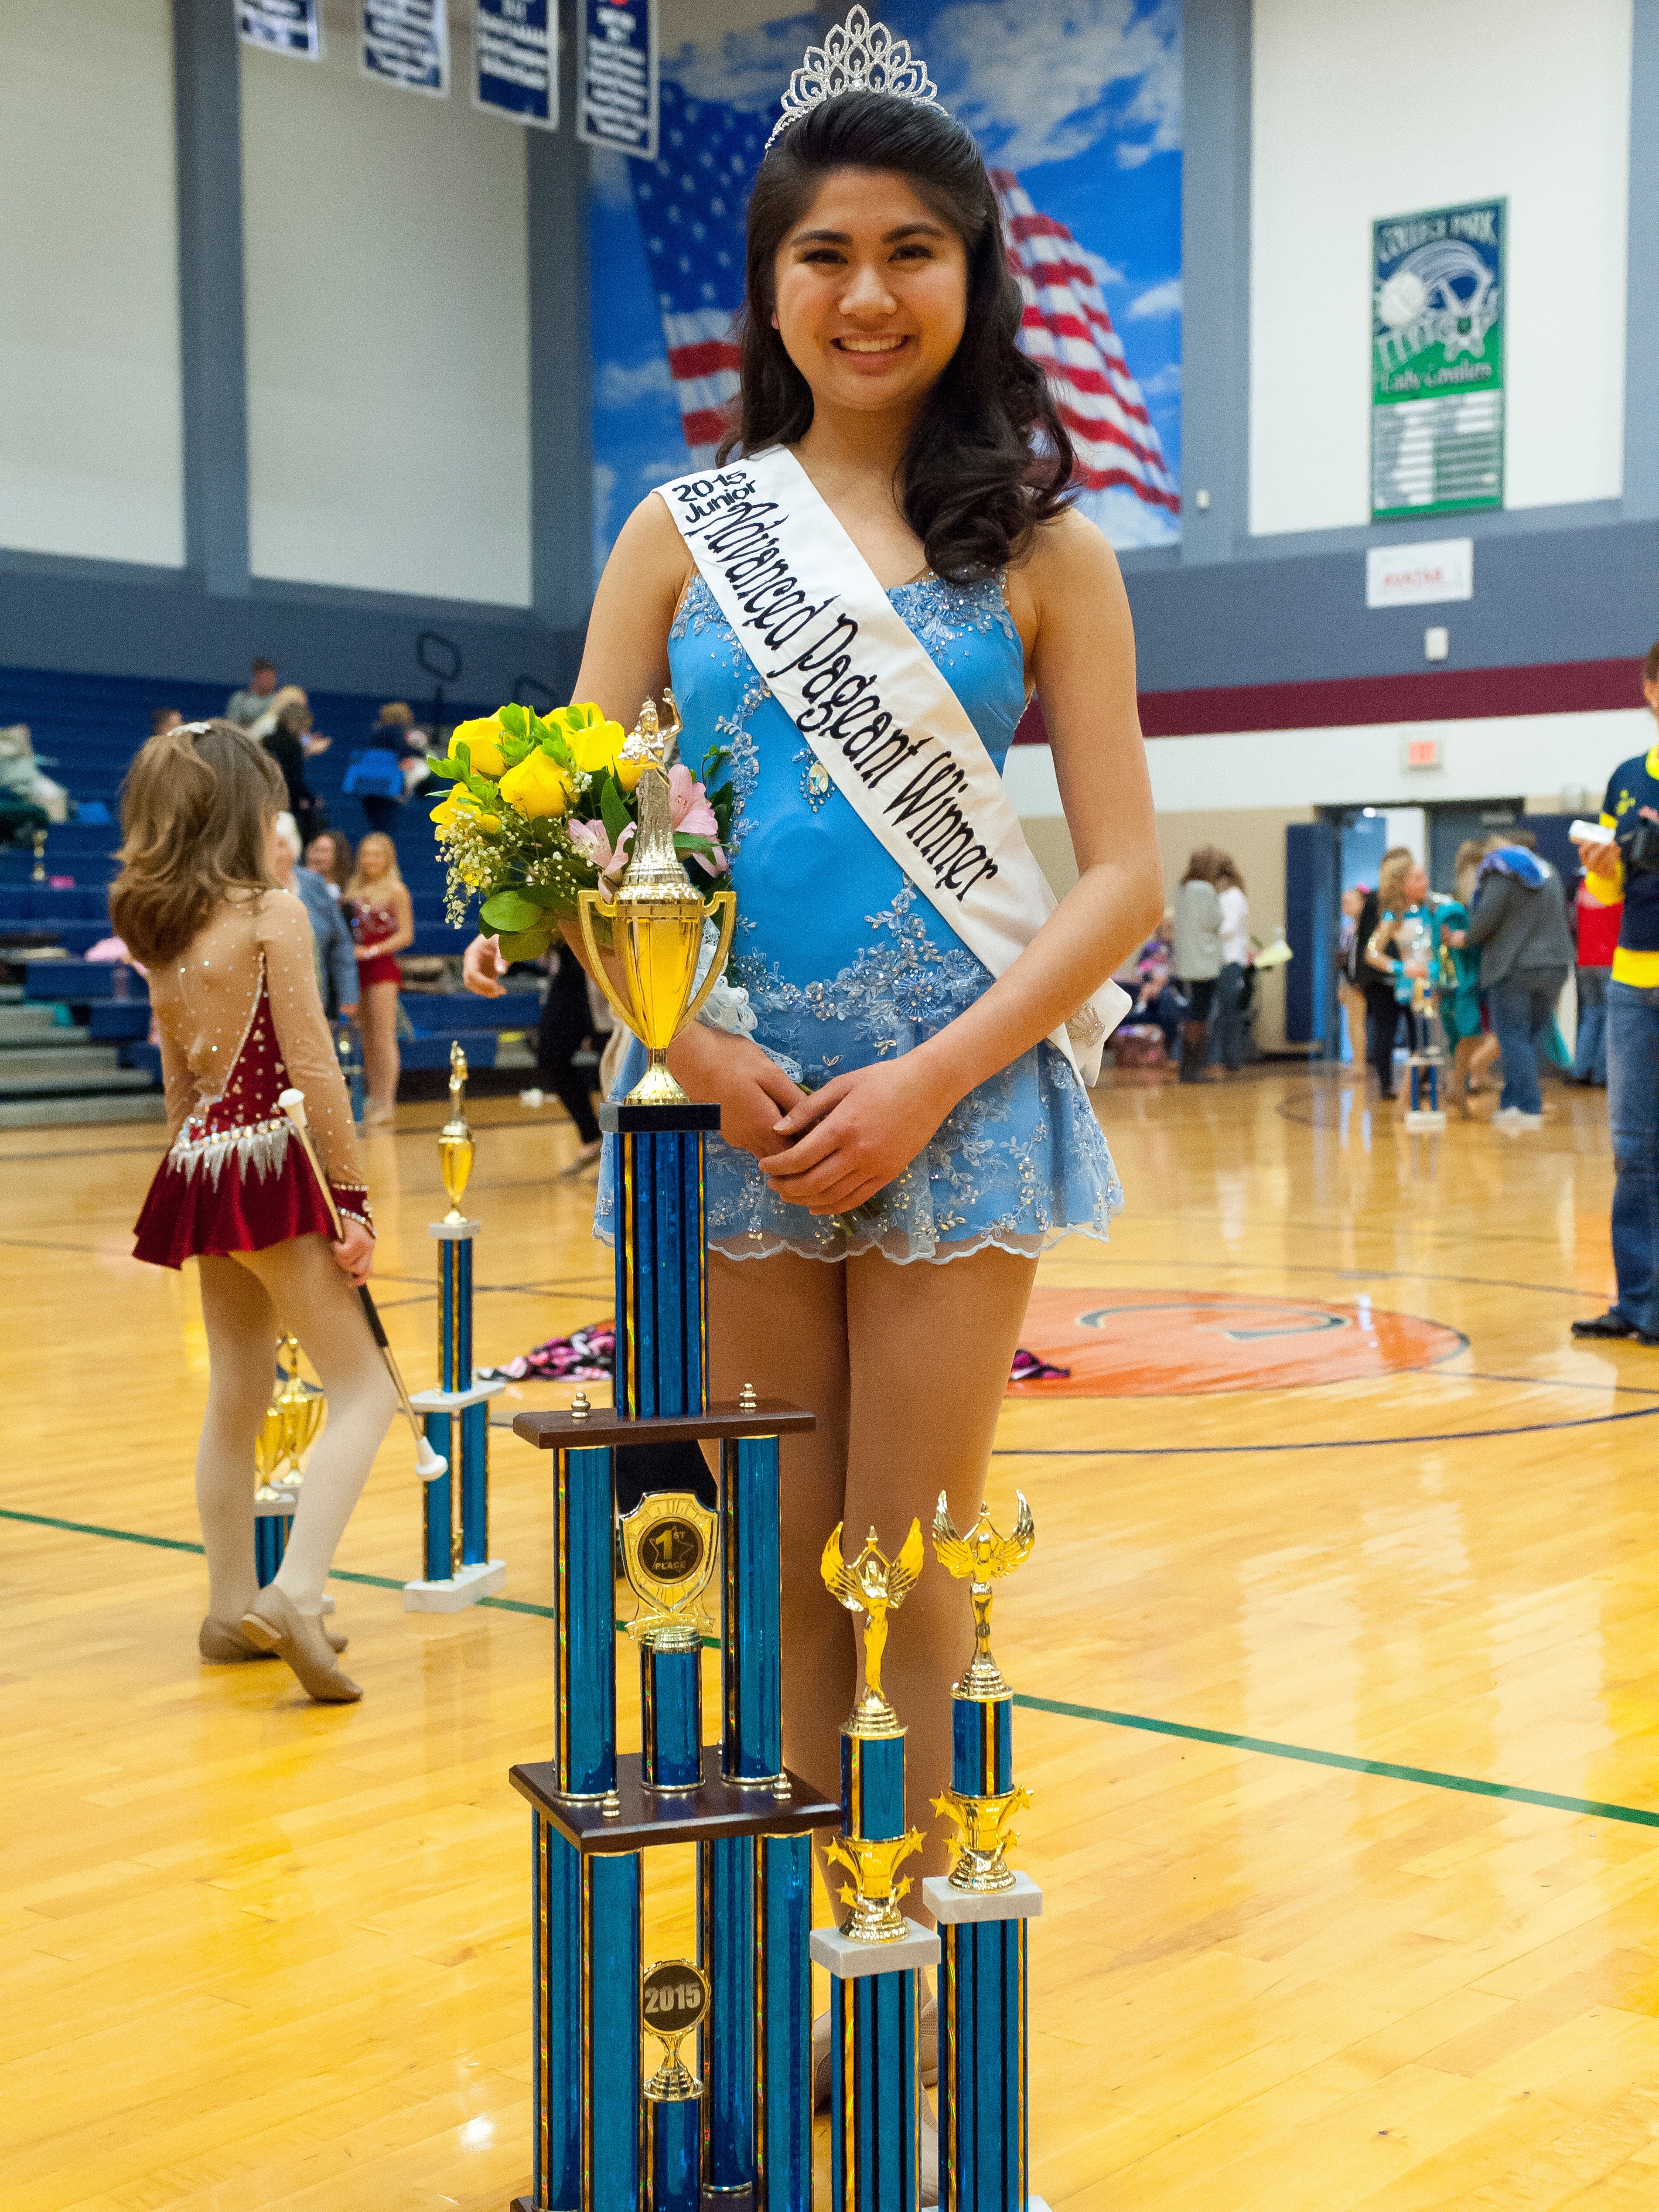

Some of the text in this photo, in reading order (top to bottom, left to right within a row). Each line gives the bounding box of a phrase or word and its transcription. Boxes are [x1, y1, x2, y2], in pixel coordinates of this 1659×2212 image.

[672, 470, 747, 502] 2015
[685, 479, 756, 523] Junior
[683, 501, 998, 902] Advanced Pageant Winner
[654, 1561, 686, 1571] PLACE
[644, 1982, 701, 2014] 2015
